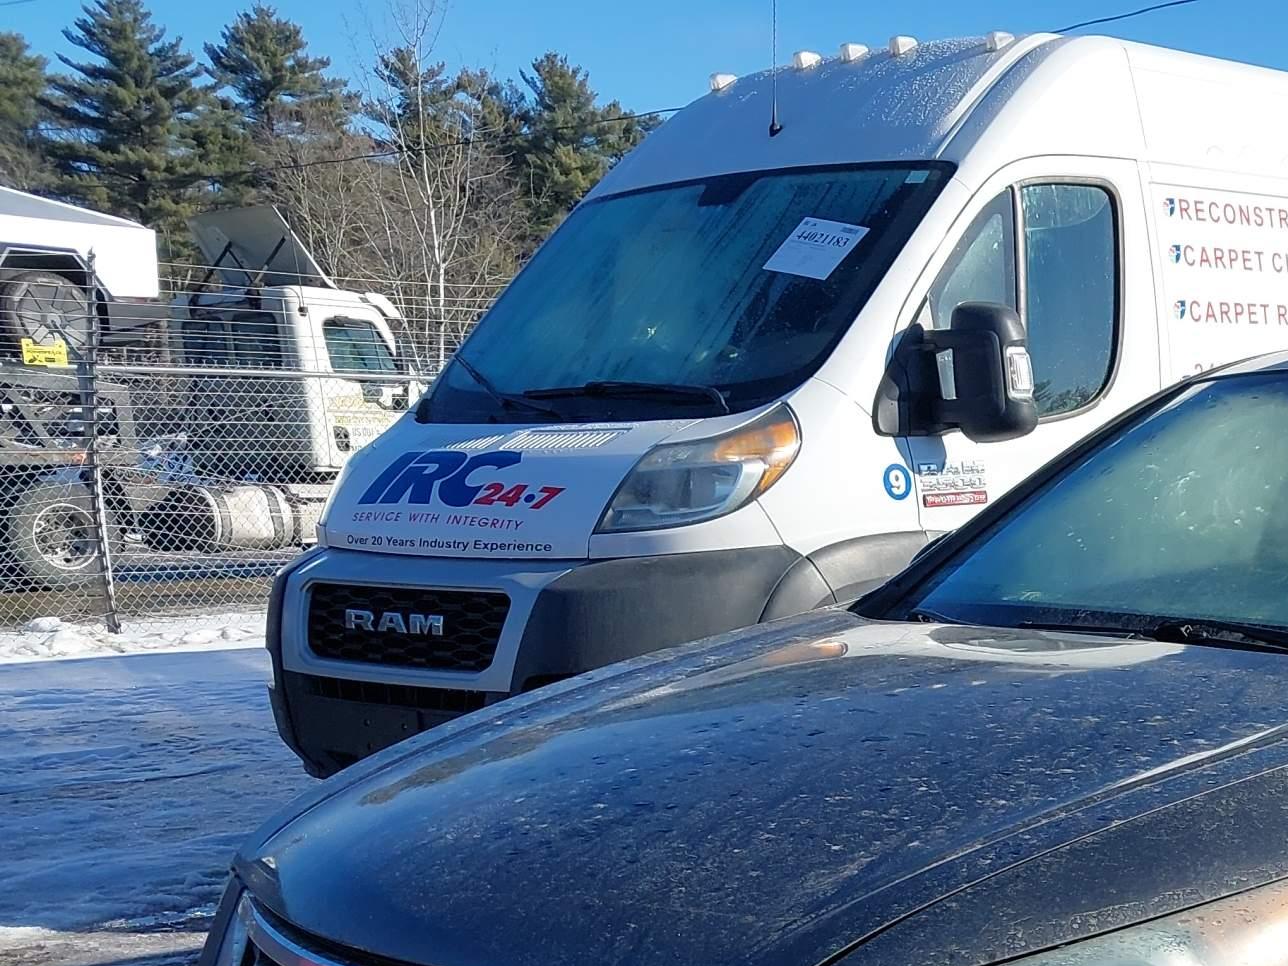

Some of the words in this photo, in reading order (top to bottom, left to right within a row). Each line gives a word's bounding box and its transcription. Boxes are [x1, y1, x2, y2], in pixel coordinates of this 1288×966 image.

[797, 229, 850, 248] 44021183
[1183, 245, 1264, 272] CARPET
[1189, 300, 1269, 325] CARPET
[358, 450, 522, 508] IRC
[352, 511, 402, 523] SERVICE
[408, 513, 440, 524] WITH
[446, 514, 524, 531] INTEGRITY
[347, 534, 369, 546] Over
[371, 535, 383, 546] 20
[385, 536, 415, 548] Years
[418, 538, 470, 552] Industry
[473, 540, 553, 553] Experience
[345, 609, 443, 636] RAM
